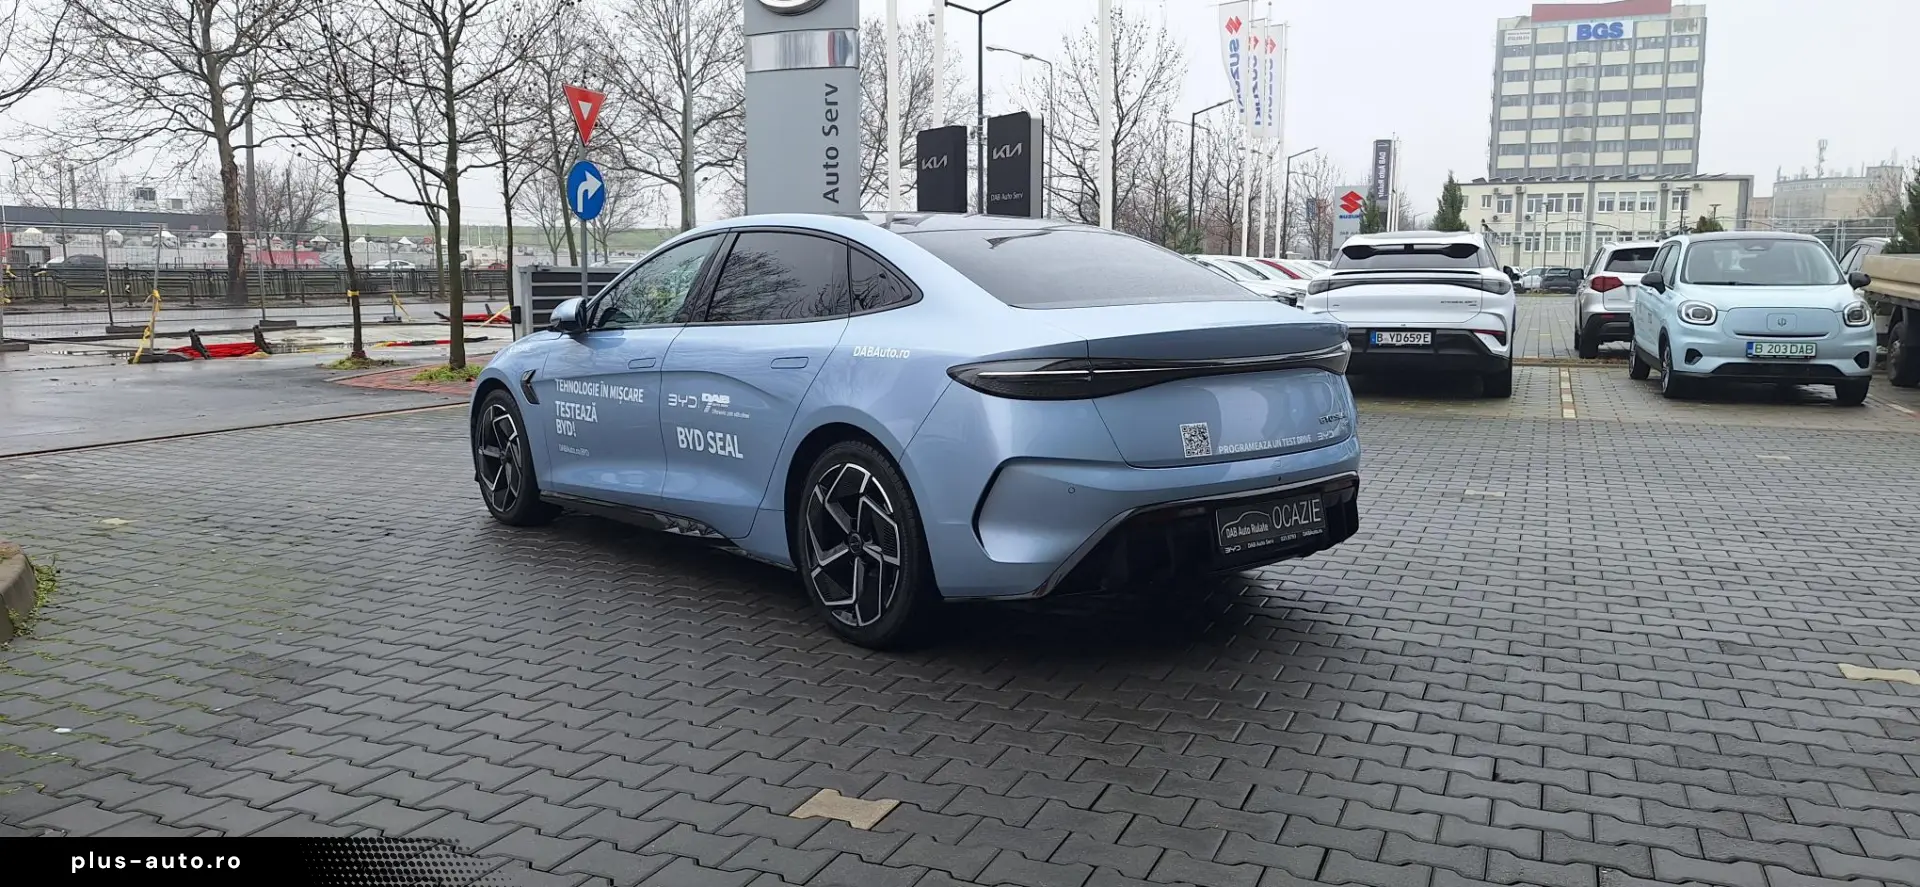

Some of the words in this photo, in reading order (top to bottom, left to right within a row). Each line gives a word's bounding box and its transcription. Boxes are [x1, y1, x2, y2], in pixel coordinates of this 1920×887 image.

[1576, 22, 1625, 41] BGS
[822, 83, 839, 137] Serv
[992, 142, 1022, 160] KIA
[921, 154, 948, 170] KIA
[822, 146, 840, 204] Auto
[1002, 192, 1012, 201] Auto
[1376, 333, 1384, 343] B
[853, 345, 911, 359] DABAuto.ro
[1754, 343, 1763, 354] B
[554, 378, 600, 397] TEHNOLOGIE
[600, 381, 609, 398] ÎN
[609, 383, 645, 404] MIȘCARE
[668, 393, 698, 409] BYD
[701, 392, 730, 405] DAB
[554, 400, 599, 423] TESTEAZĂ
[555, 418, 577, 438] BYD!
[676, 426, 705, 452] BYD
[706, 430, 744, 459] SEAL
[1272, 439, 1281, 449] UN
[1281, 436, 1297, 447] TEST
[1296, 434, 1313, 445] DRIVE
[1272, 498, 1322, 529] OCAZIE
[1225, 526, 1238, 539] DAB
[1239, 525, 1251, 536] Auto
